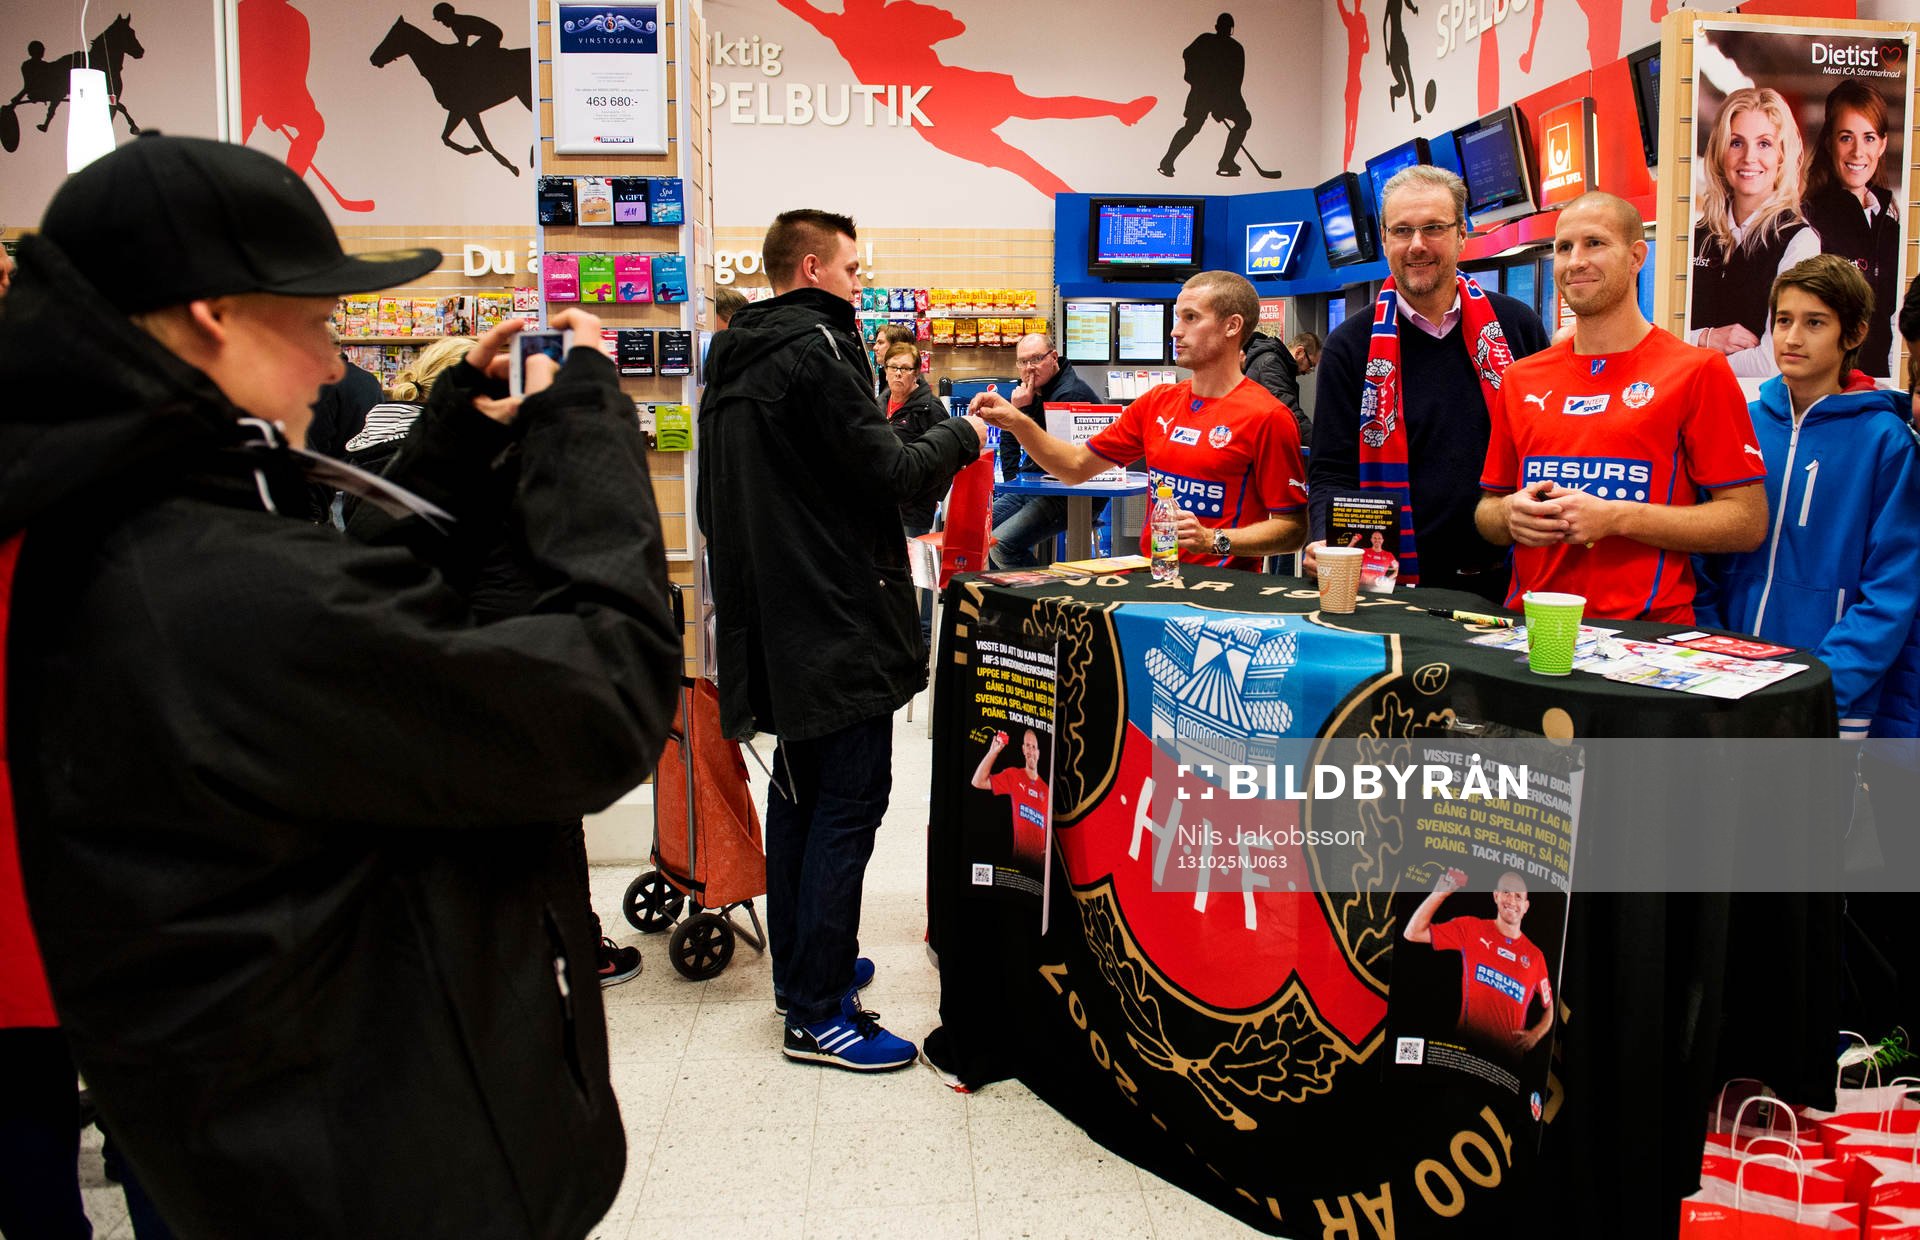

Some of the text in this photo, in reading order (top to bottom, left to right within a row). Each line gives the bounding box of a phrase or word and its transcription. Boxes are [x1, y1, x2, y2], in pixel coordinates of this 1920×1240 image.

[708, 31, 783, 77] ktig
[1812, 43, 1878, 66] Dietist
[1822, 66, 1901, 78] Maxi ICA Stormarknad
[586, 96, 638, 106] 463 680:-
[711, 82, 934, 127] PELBUTIK
[464, 244, 515, 276] Du
[1252, 257, 1281, 268] ATG
[1584, 404, 1602, 412] SPORT
[1528, 462, 1648, 483] RESURS
[976, 640, 998, 652] VISSTE
[1000, 643, 1008, 654] DU
[1024, 650, 1036, 661] KAN
[977, 667, 1000, 678] UPPGE
[1001, 670, 1010, 680] HIF
[1011, 673, 1022, 684] SOM
[1023, 676, 1035, 688] DITT
[1036, 680, 1047, 690] LAG
[986, 680, 1004, 692] GÅNG
[1006, 685, 1014, 694] DU
[1015, 687, 1034, 700] SPELAR
[1035, 693, 1047, 704] MED
[976, 693, 1008, 706] SVENSKA
[1039, 706, 1046, 717] SÅ
[982, 707, 1008, 720] POÄNG.
[1009, 712, 1024, 723] TACK
[1024, 716, 1034, 727] FÖR
[1035, 720, 1047, 732] DITT
[1424, 749, 1463, 766] VISSTE
[1550, 777, 1572, 796] BIDR
[1434, 800, 1467, 819] GÅNG
[1470, 809, 1486, 823] DU
[1490, 813, 1532, 837] SPELAR
[1535, 828, 1556, 846] MED
[1485, 797, 1510, 812] SOM
[1513, 803, 1539, 820] DITT
[1540, 811, 1561, 829] LAG
[1416, 818, 1569, 874] SVENSKA SPEL-KORT, SÅ FÅR
[1425, 836, 1468, 854] POÄNG.
[1472, 844, 1501, 863] TACK
[1503, 852, 1524, 870] FÖR
[1528, 862, 1550, 880] DITT
[1476, 973, 1508, 993] BANK
[1415, 1105, 1512, 1218] 100
